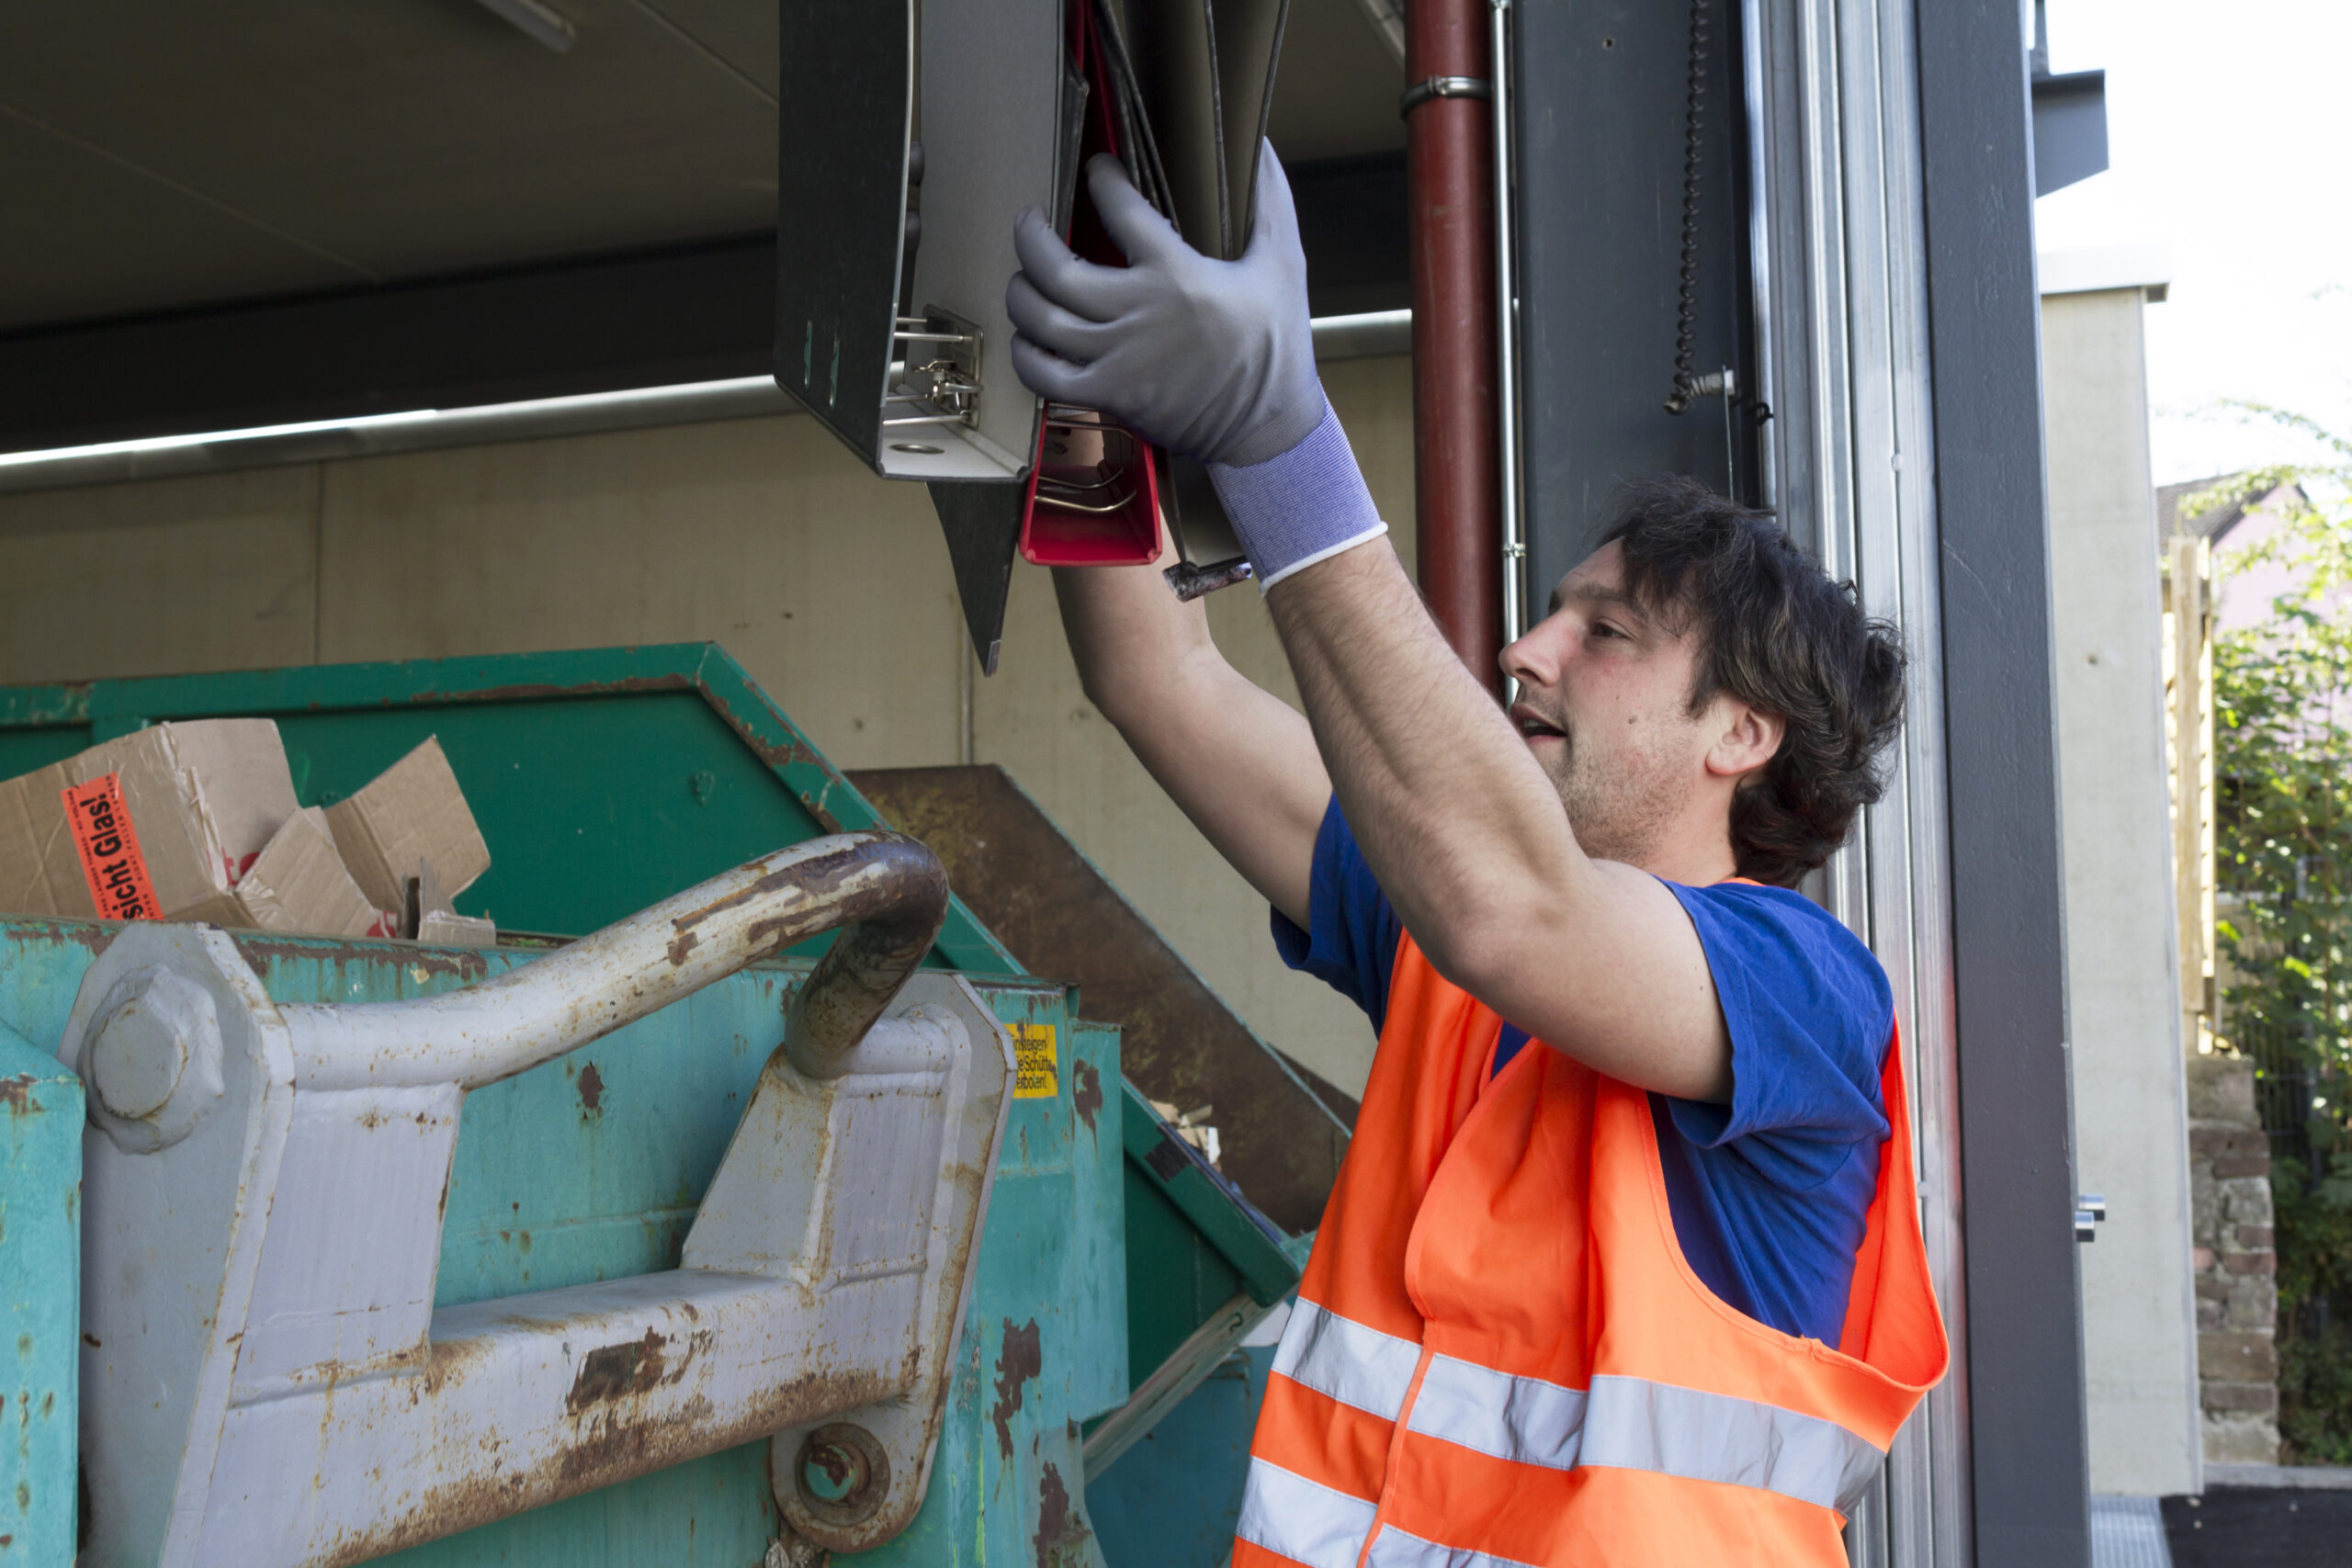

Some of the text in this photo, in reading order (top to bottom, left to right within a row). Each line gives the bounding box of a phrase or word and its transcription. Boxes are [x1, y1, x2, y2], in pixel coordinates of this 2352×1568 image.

[106, 775, 119, 811] LASSEN
[119, 816, 131, 850] FALLEN
[80, 794, 143, 919] sicht Glas!
[130, 856, 141, 881] NICHT
[1012, 1036, 1047, 1055] insteigen
[1016, 1073, 1046, 1089] erboten!
